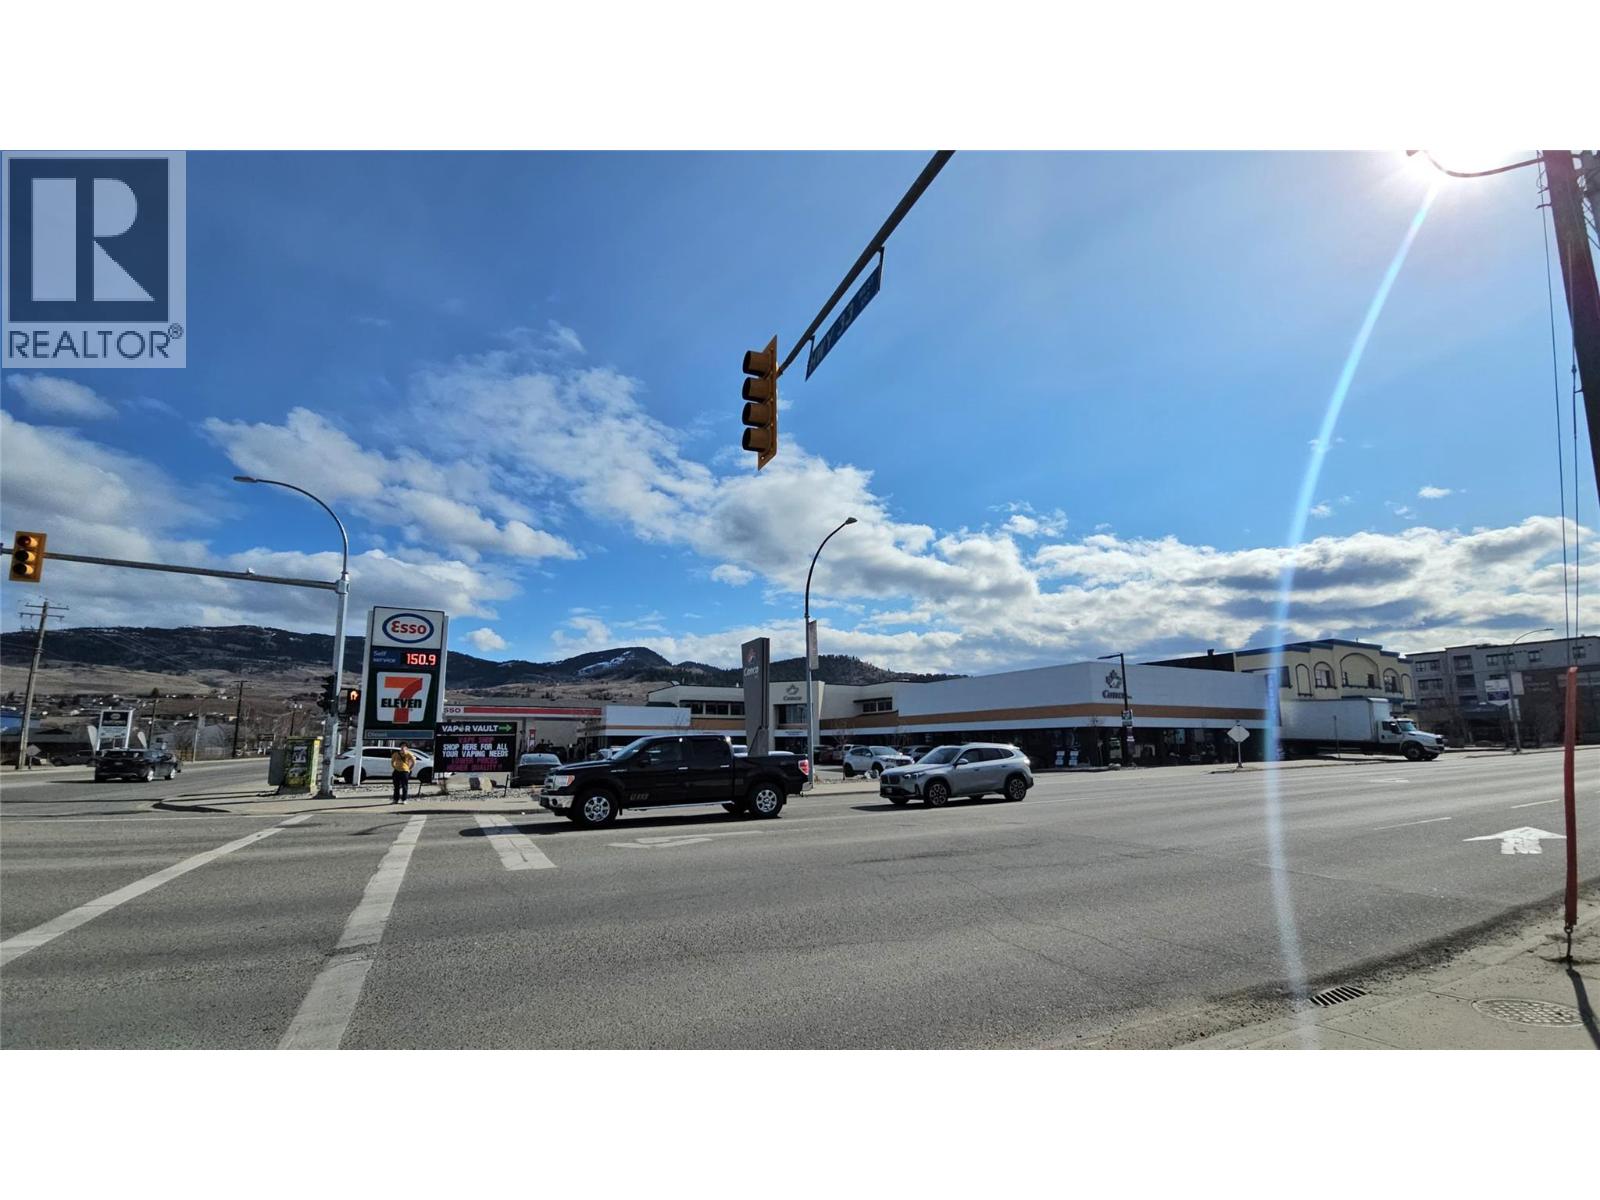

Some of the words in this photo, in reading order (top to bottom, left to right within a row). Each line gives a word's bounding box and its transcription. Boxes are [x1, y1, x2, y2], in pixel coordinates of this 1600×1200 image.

[406, 653, 437, 666] 150.9
[472, 724, 499, 732] VAULT
[443, 743, 459, 751] SHOP
[497, 743, 508, 751] ALL
